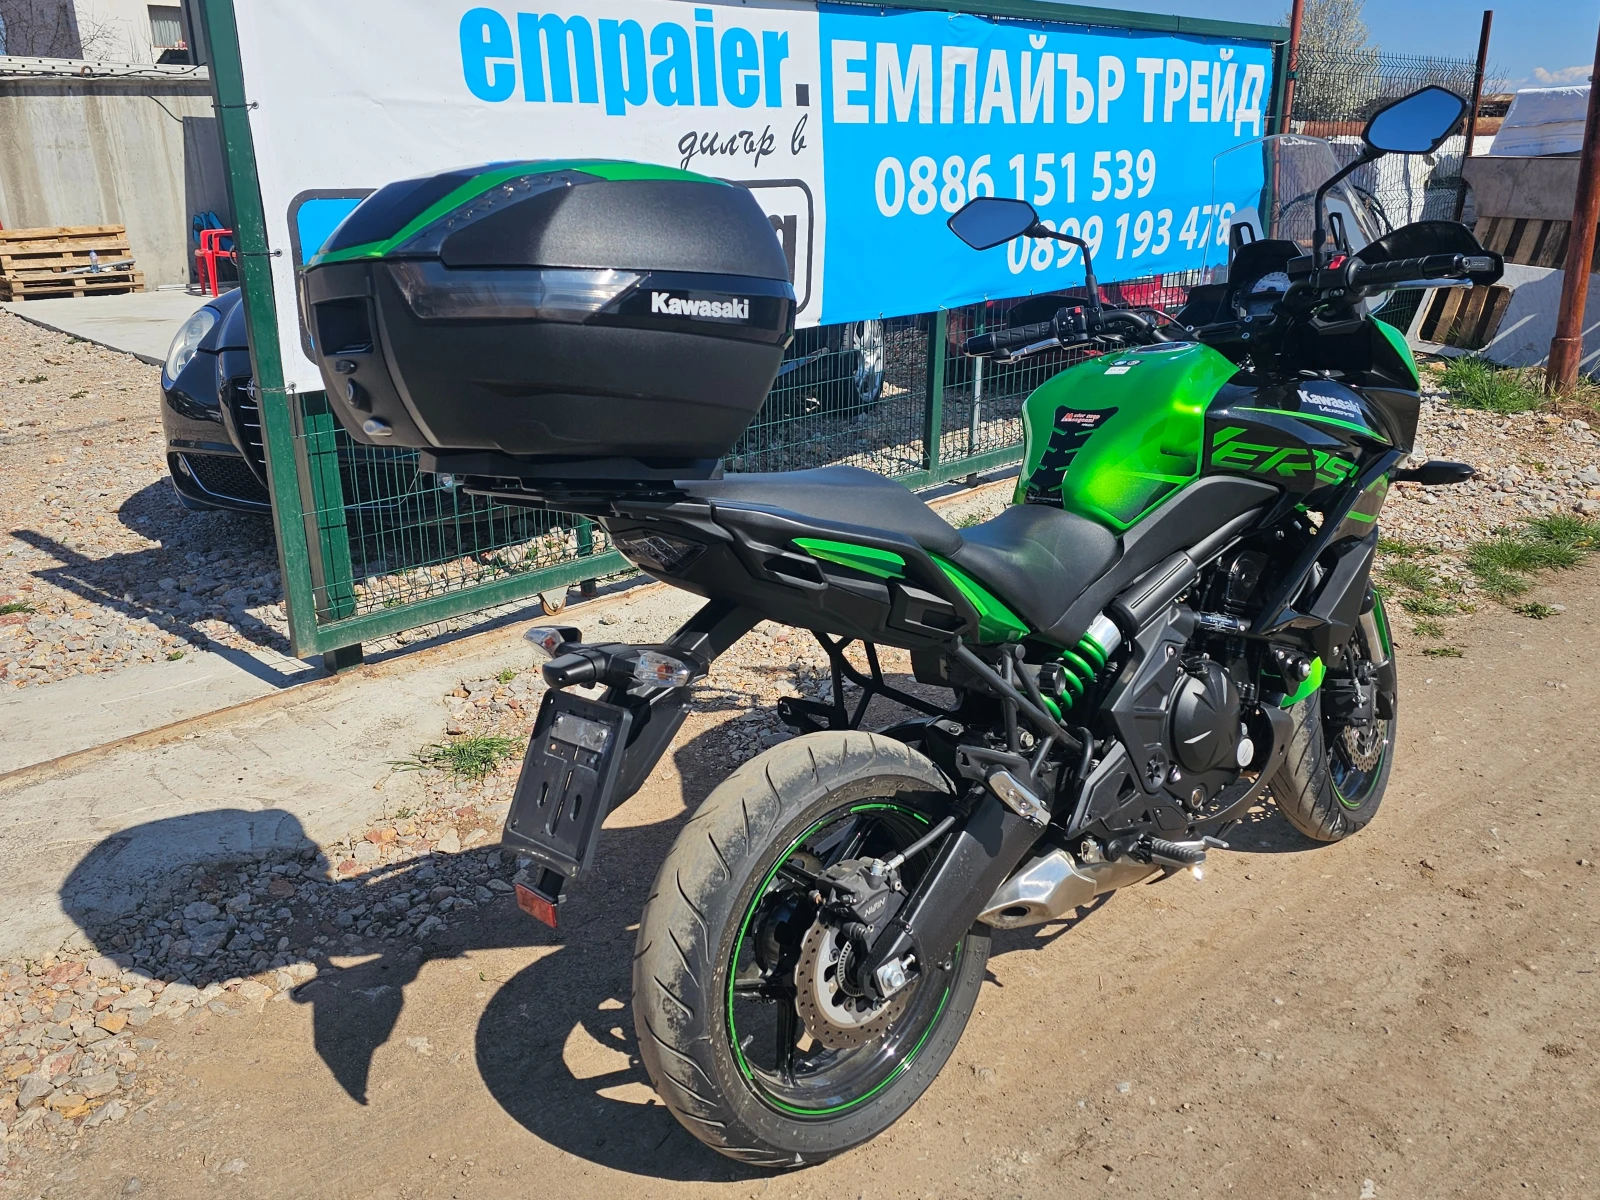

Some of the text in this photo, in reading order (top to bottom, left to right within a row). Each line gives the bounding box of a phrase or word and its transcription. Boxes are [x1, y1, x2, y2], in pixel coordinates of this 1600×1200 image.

[831, 34, 1266, 137] ЕМПАЙЪР ТРЕЙД
[874, 148, 1157, 217] 0886 151 539
[1007, 202, 1237, 275] 0899 193 478
[651, 291, 750, 319] Kawasaki
[1296, 389, 1363, 416] Kawasaki
